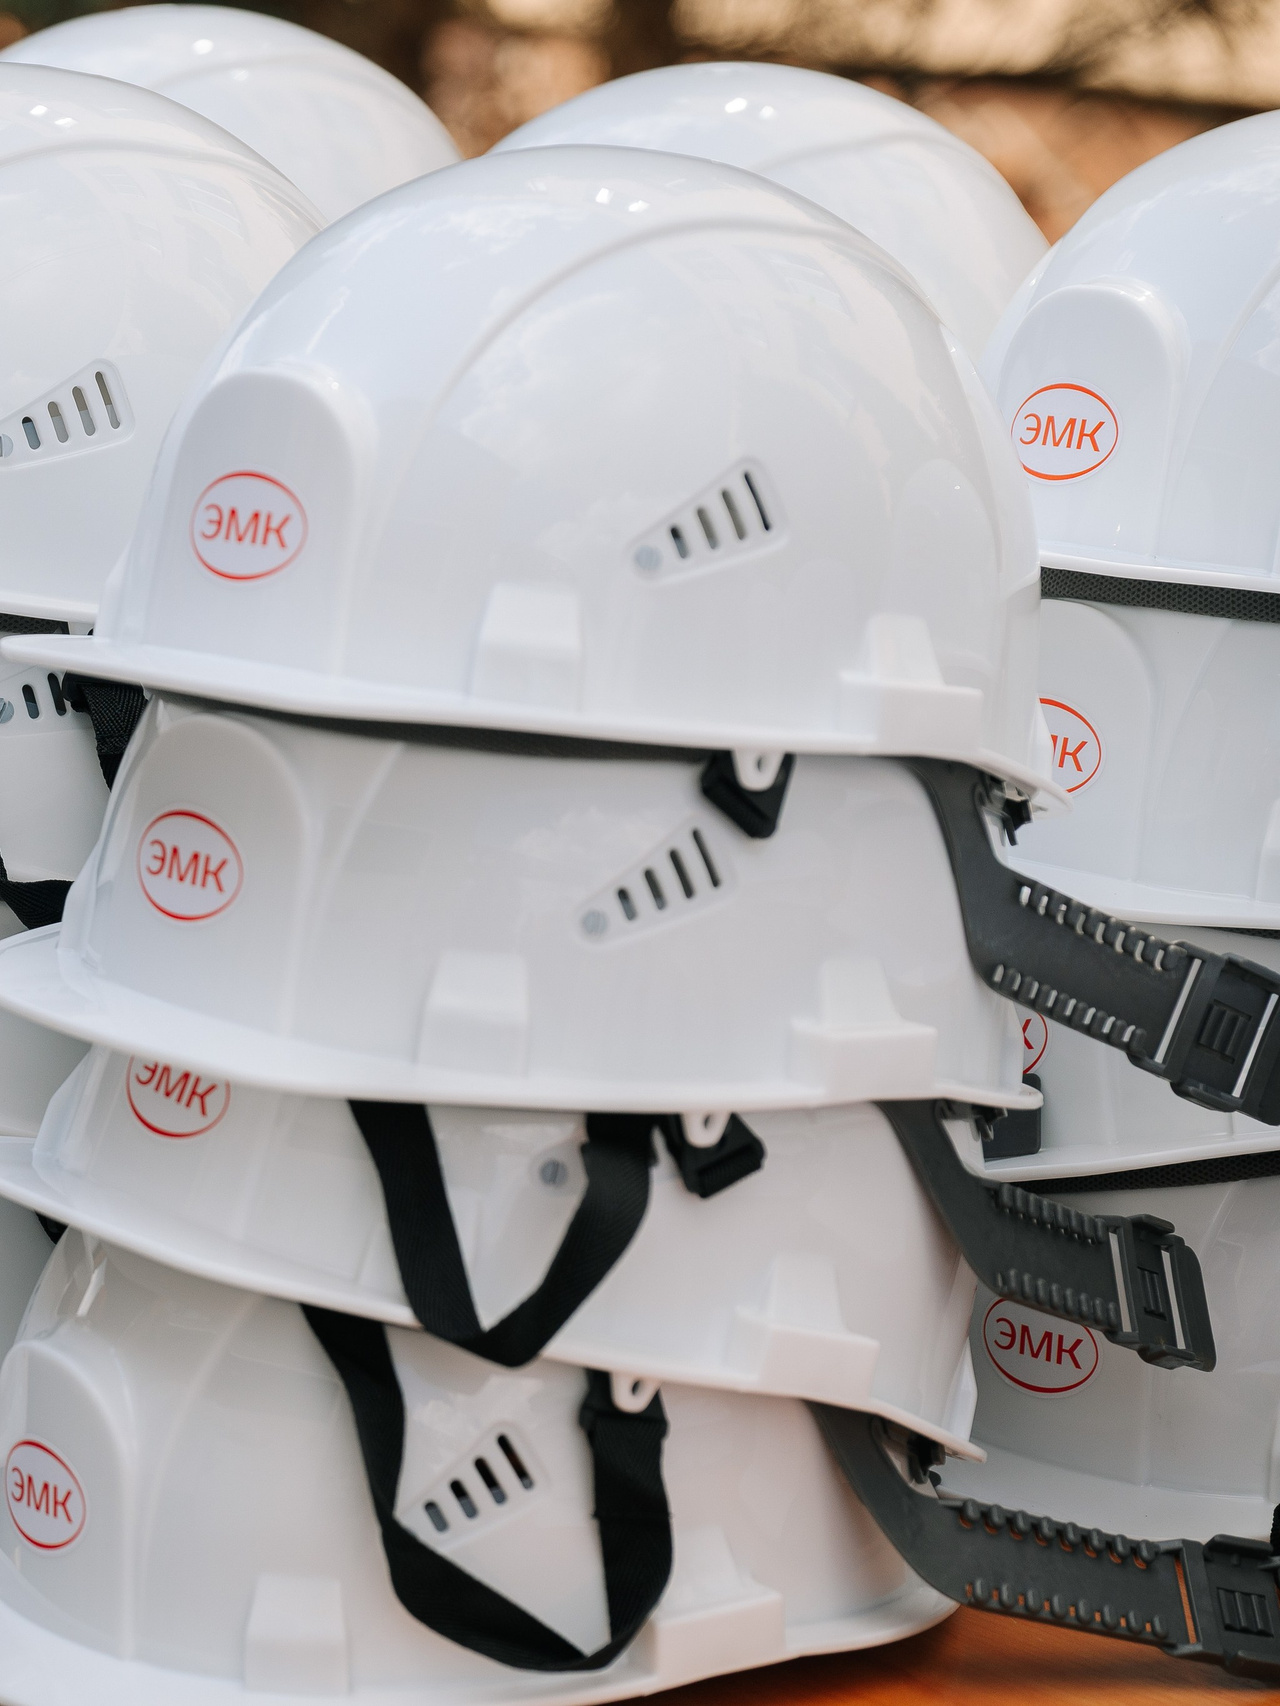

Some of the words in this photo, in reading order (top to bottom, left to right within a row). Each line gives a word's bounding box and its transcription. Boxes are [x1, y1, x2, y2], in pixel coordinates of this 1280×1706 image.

[1018, 412, 1106, 453] ЭМК
[201, 503, 291, 549] ЭМК
[146, 838, 228, 893] ЭМК
[993, 1316, 1084, 1371] ЭМК
[10, 1466, 74, 1523] ЭМК
